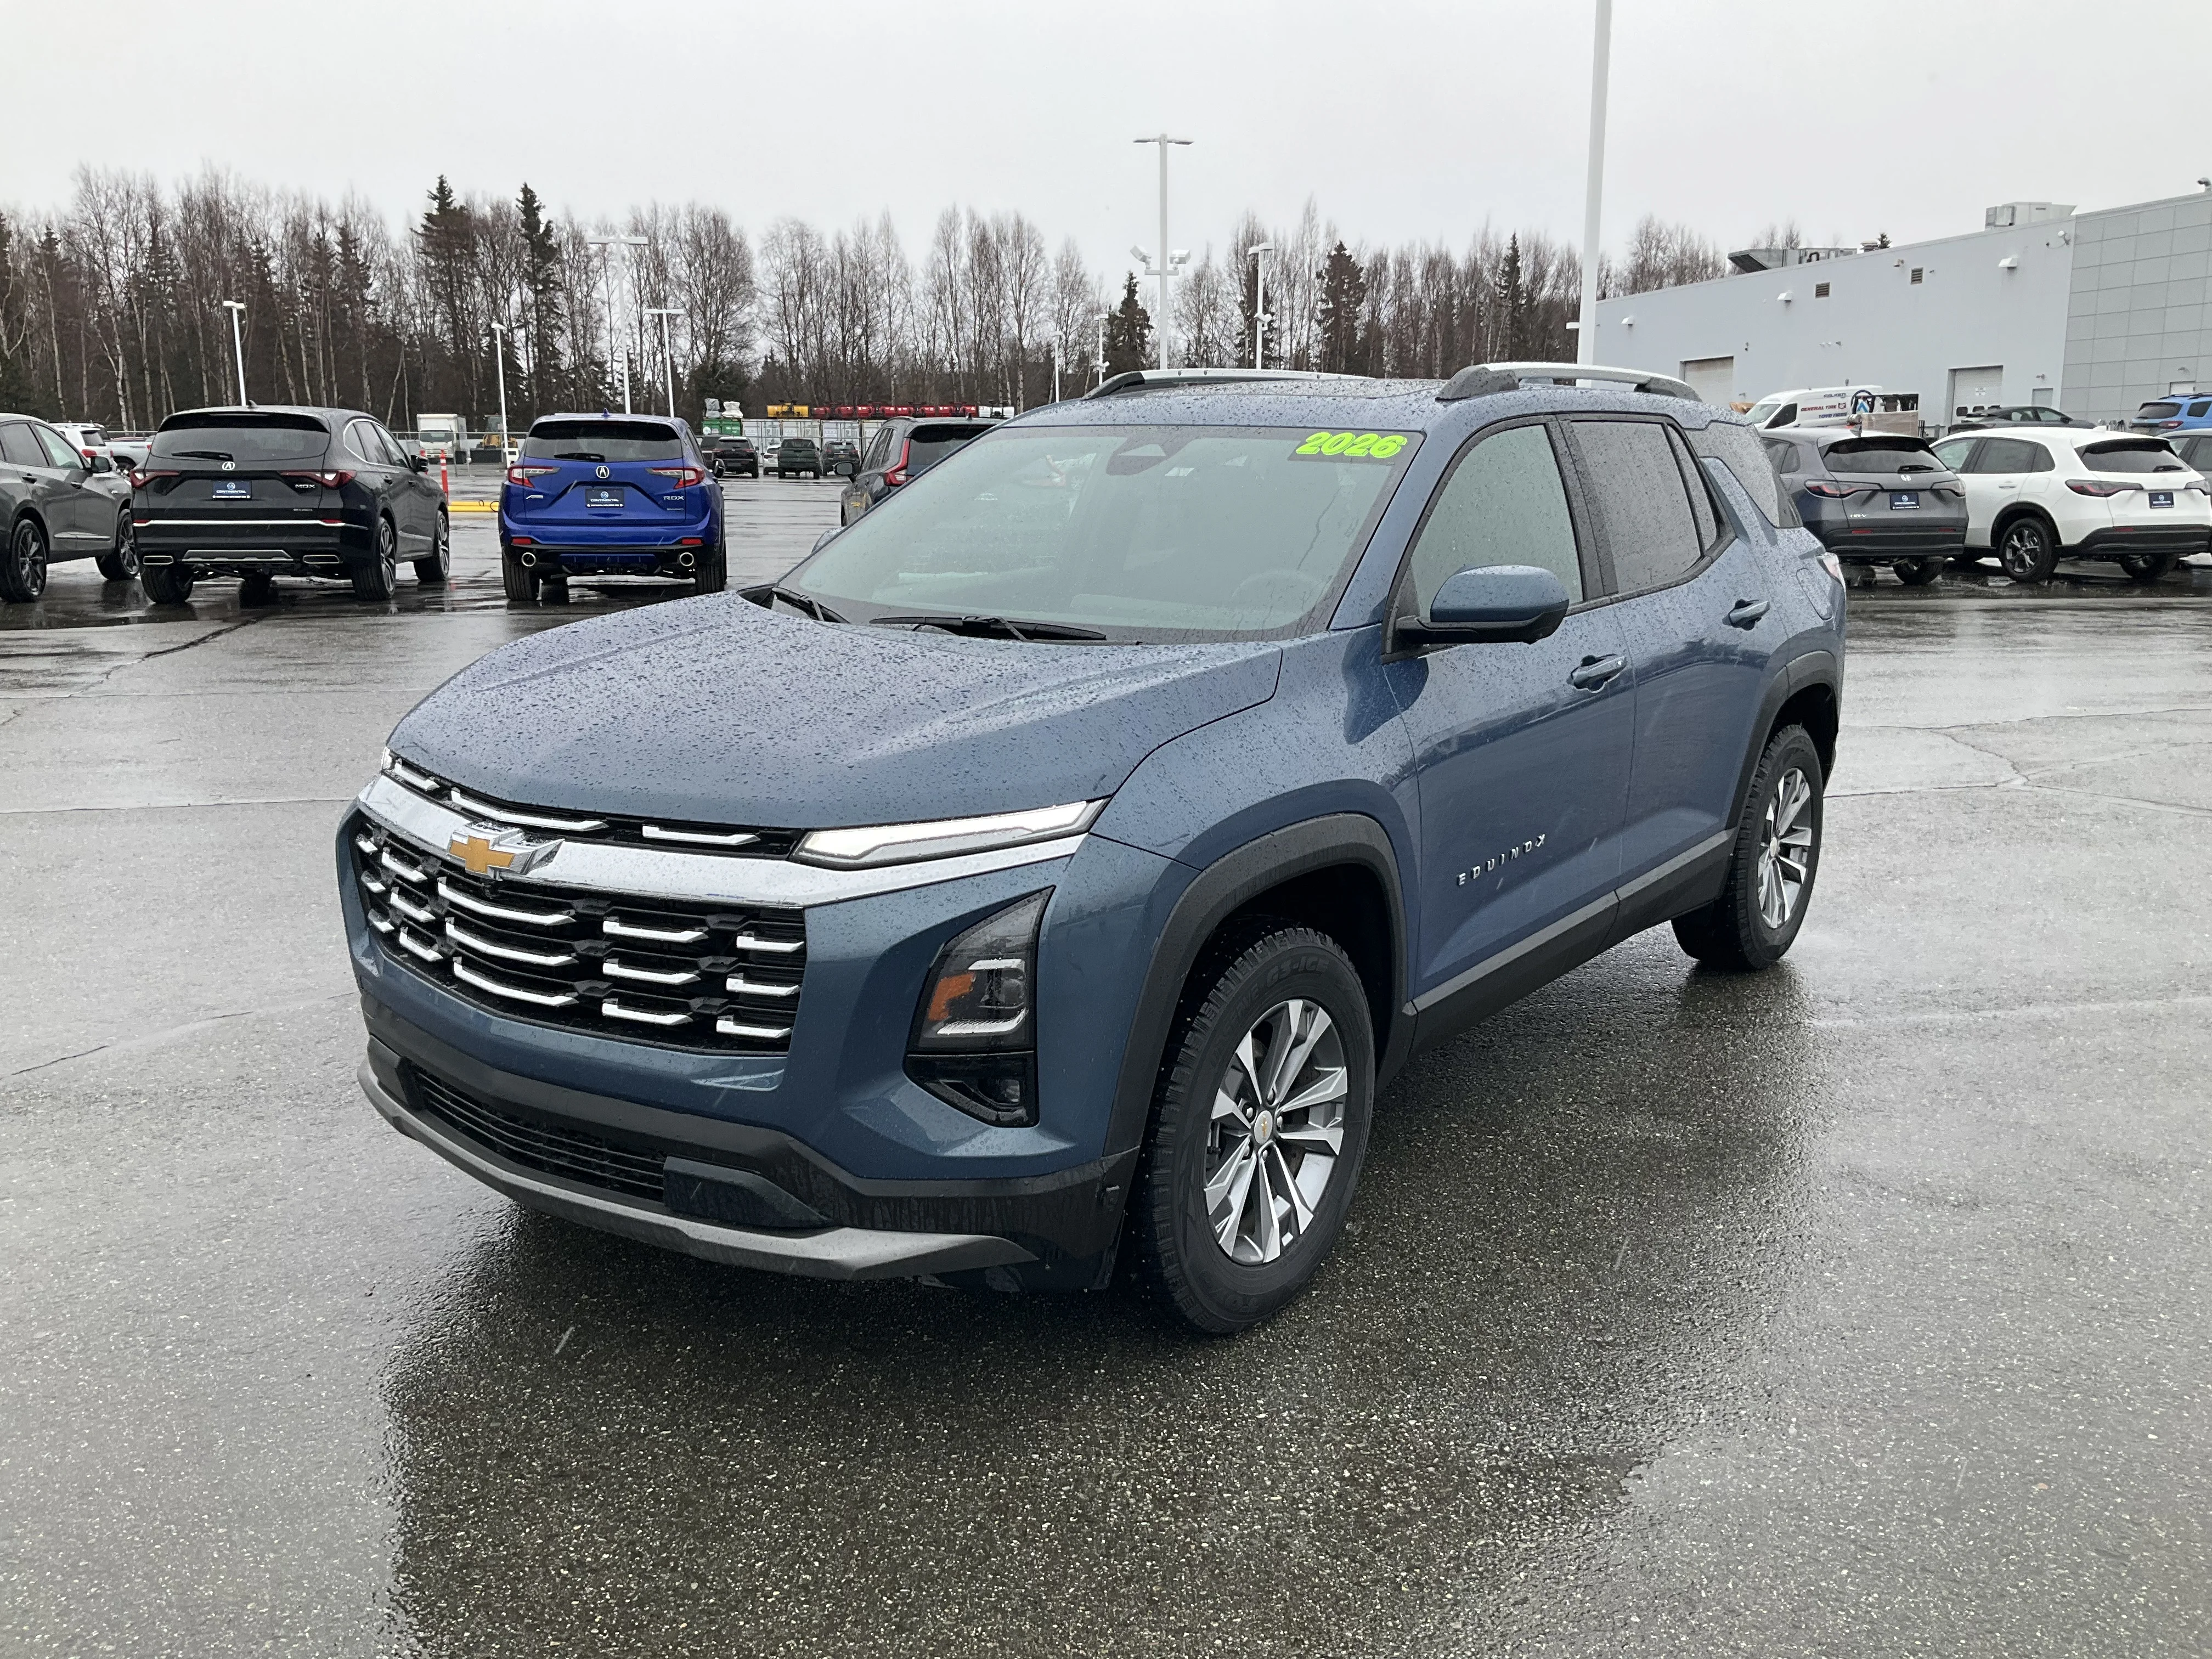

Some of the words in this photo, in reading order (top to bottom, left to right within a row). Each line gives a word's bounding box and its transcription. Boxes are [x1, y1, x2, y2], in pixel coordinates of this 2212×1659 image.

[1295, 432, 1407, 459] 2026
[1457, 834, 1545, 886] EQUINOX
[1266, 956, 1330, 988] G3-ICE
